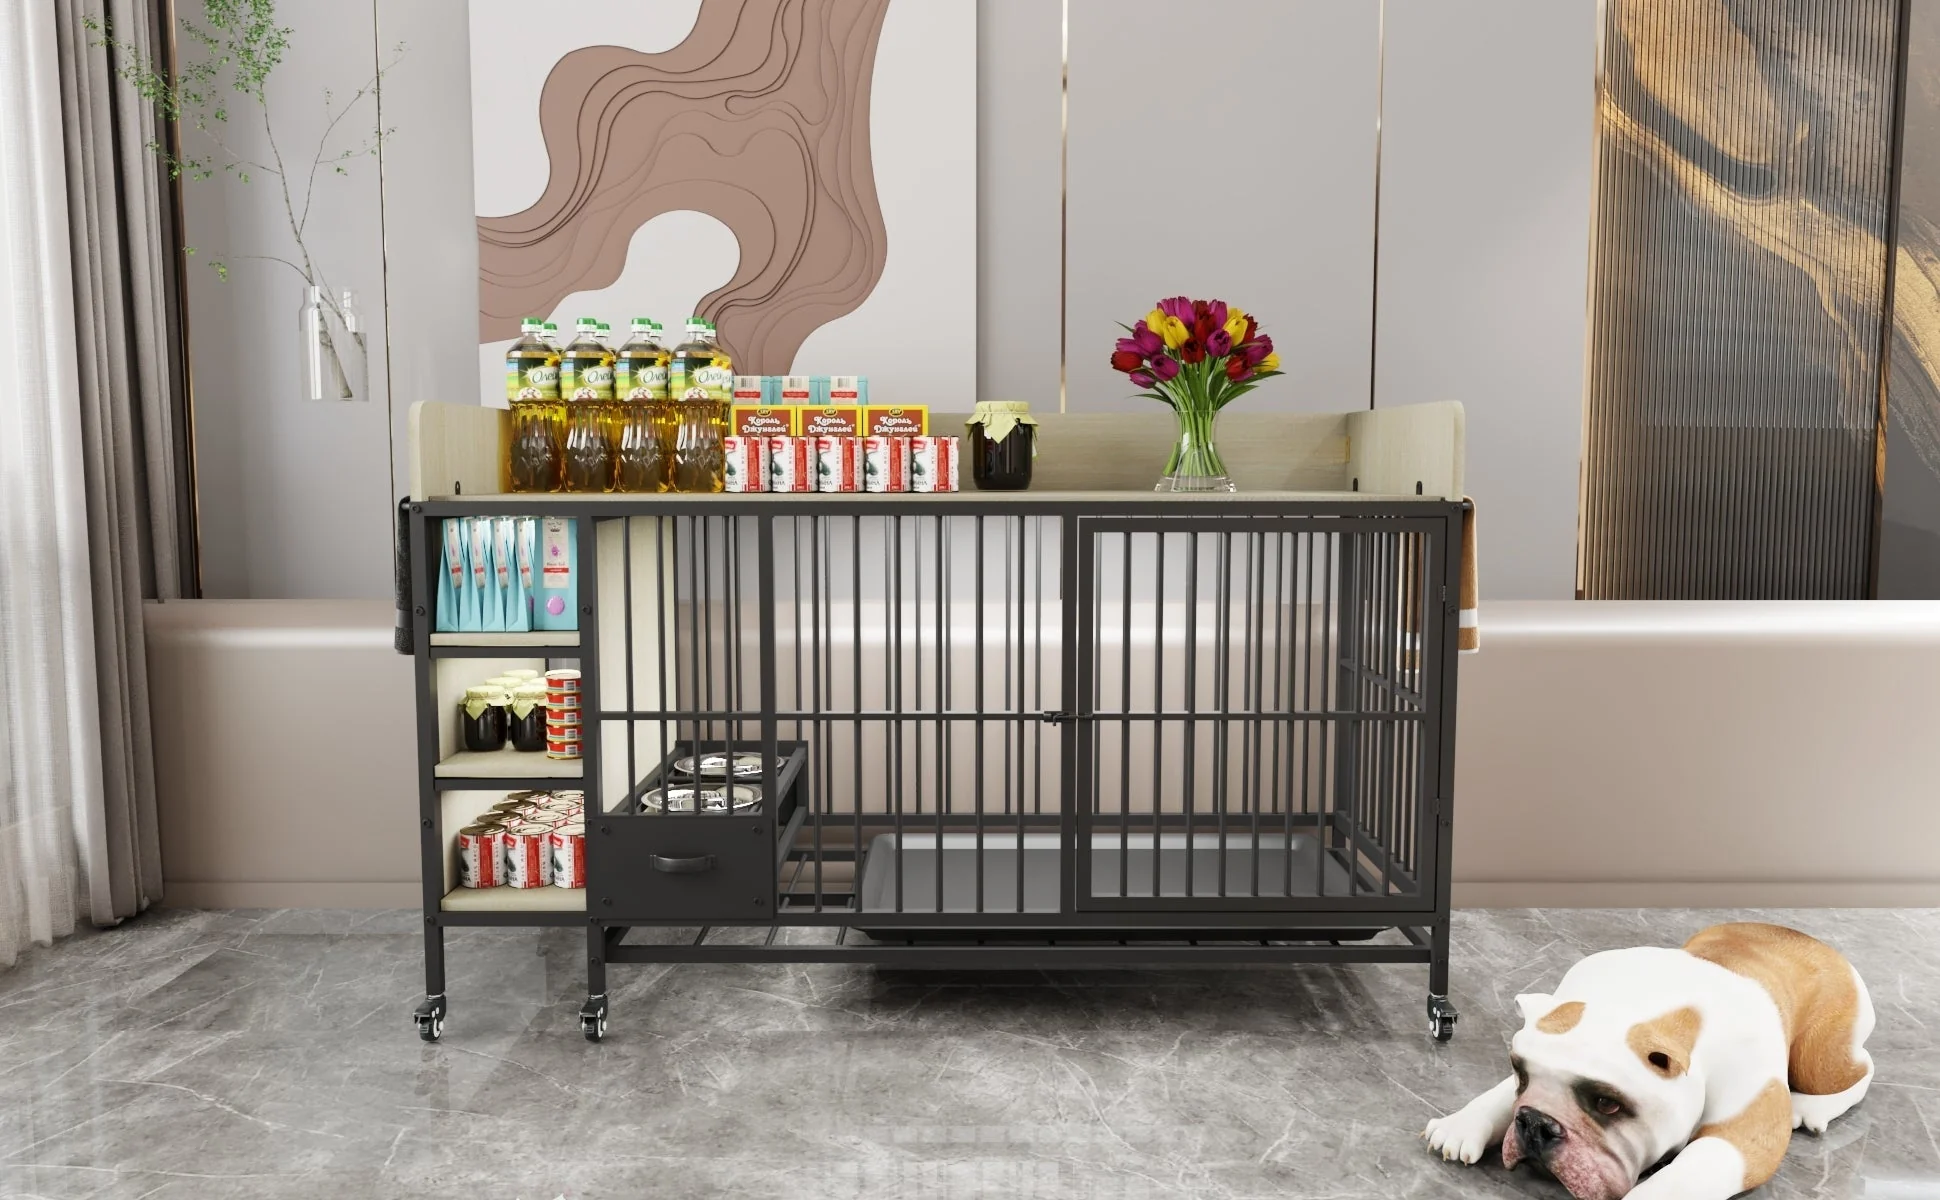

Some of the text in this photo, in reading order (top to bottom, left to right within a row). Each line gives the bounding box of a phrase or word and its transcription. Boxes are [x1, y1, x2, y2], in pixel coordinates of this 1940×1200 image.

[748, 415, 780, 426] Король
[814, 415, 846, 426] Король
[880, 415, 912, 426] Король
[741, 424, 786, 434] Джунглей
[808, 424, 853, 434] Джунглей
[874, 424, 919, 434] Джунглей
